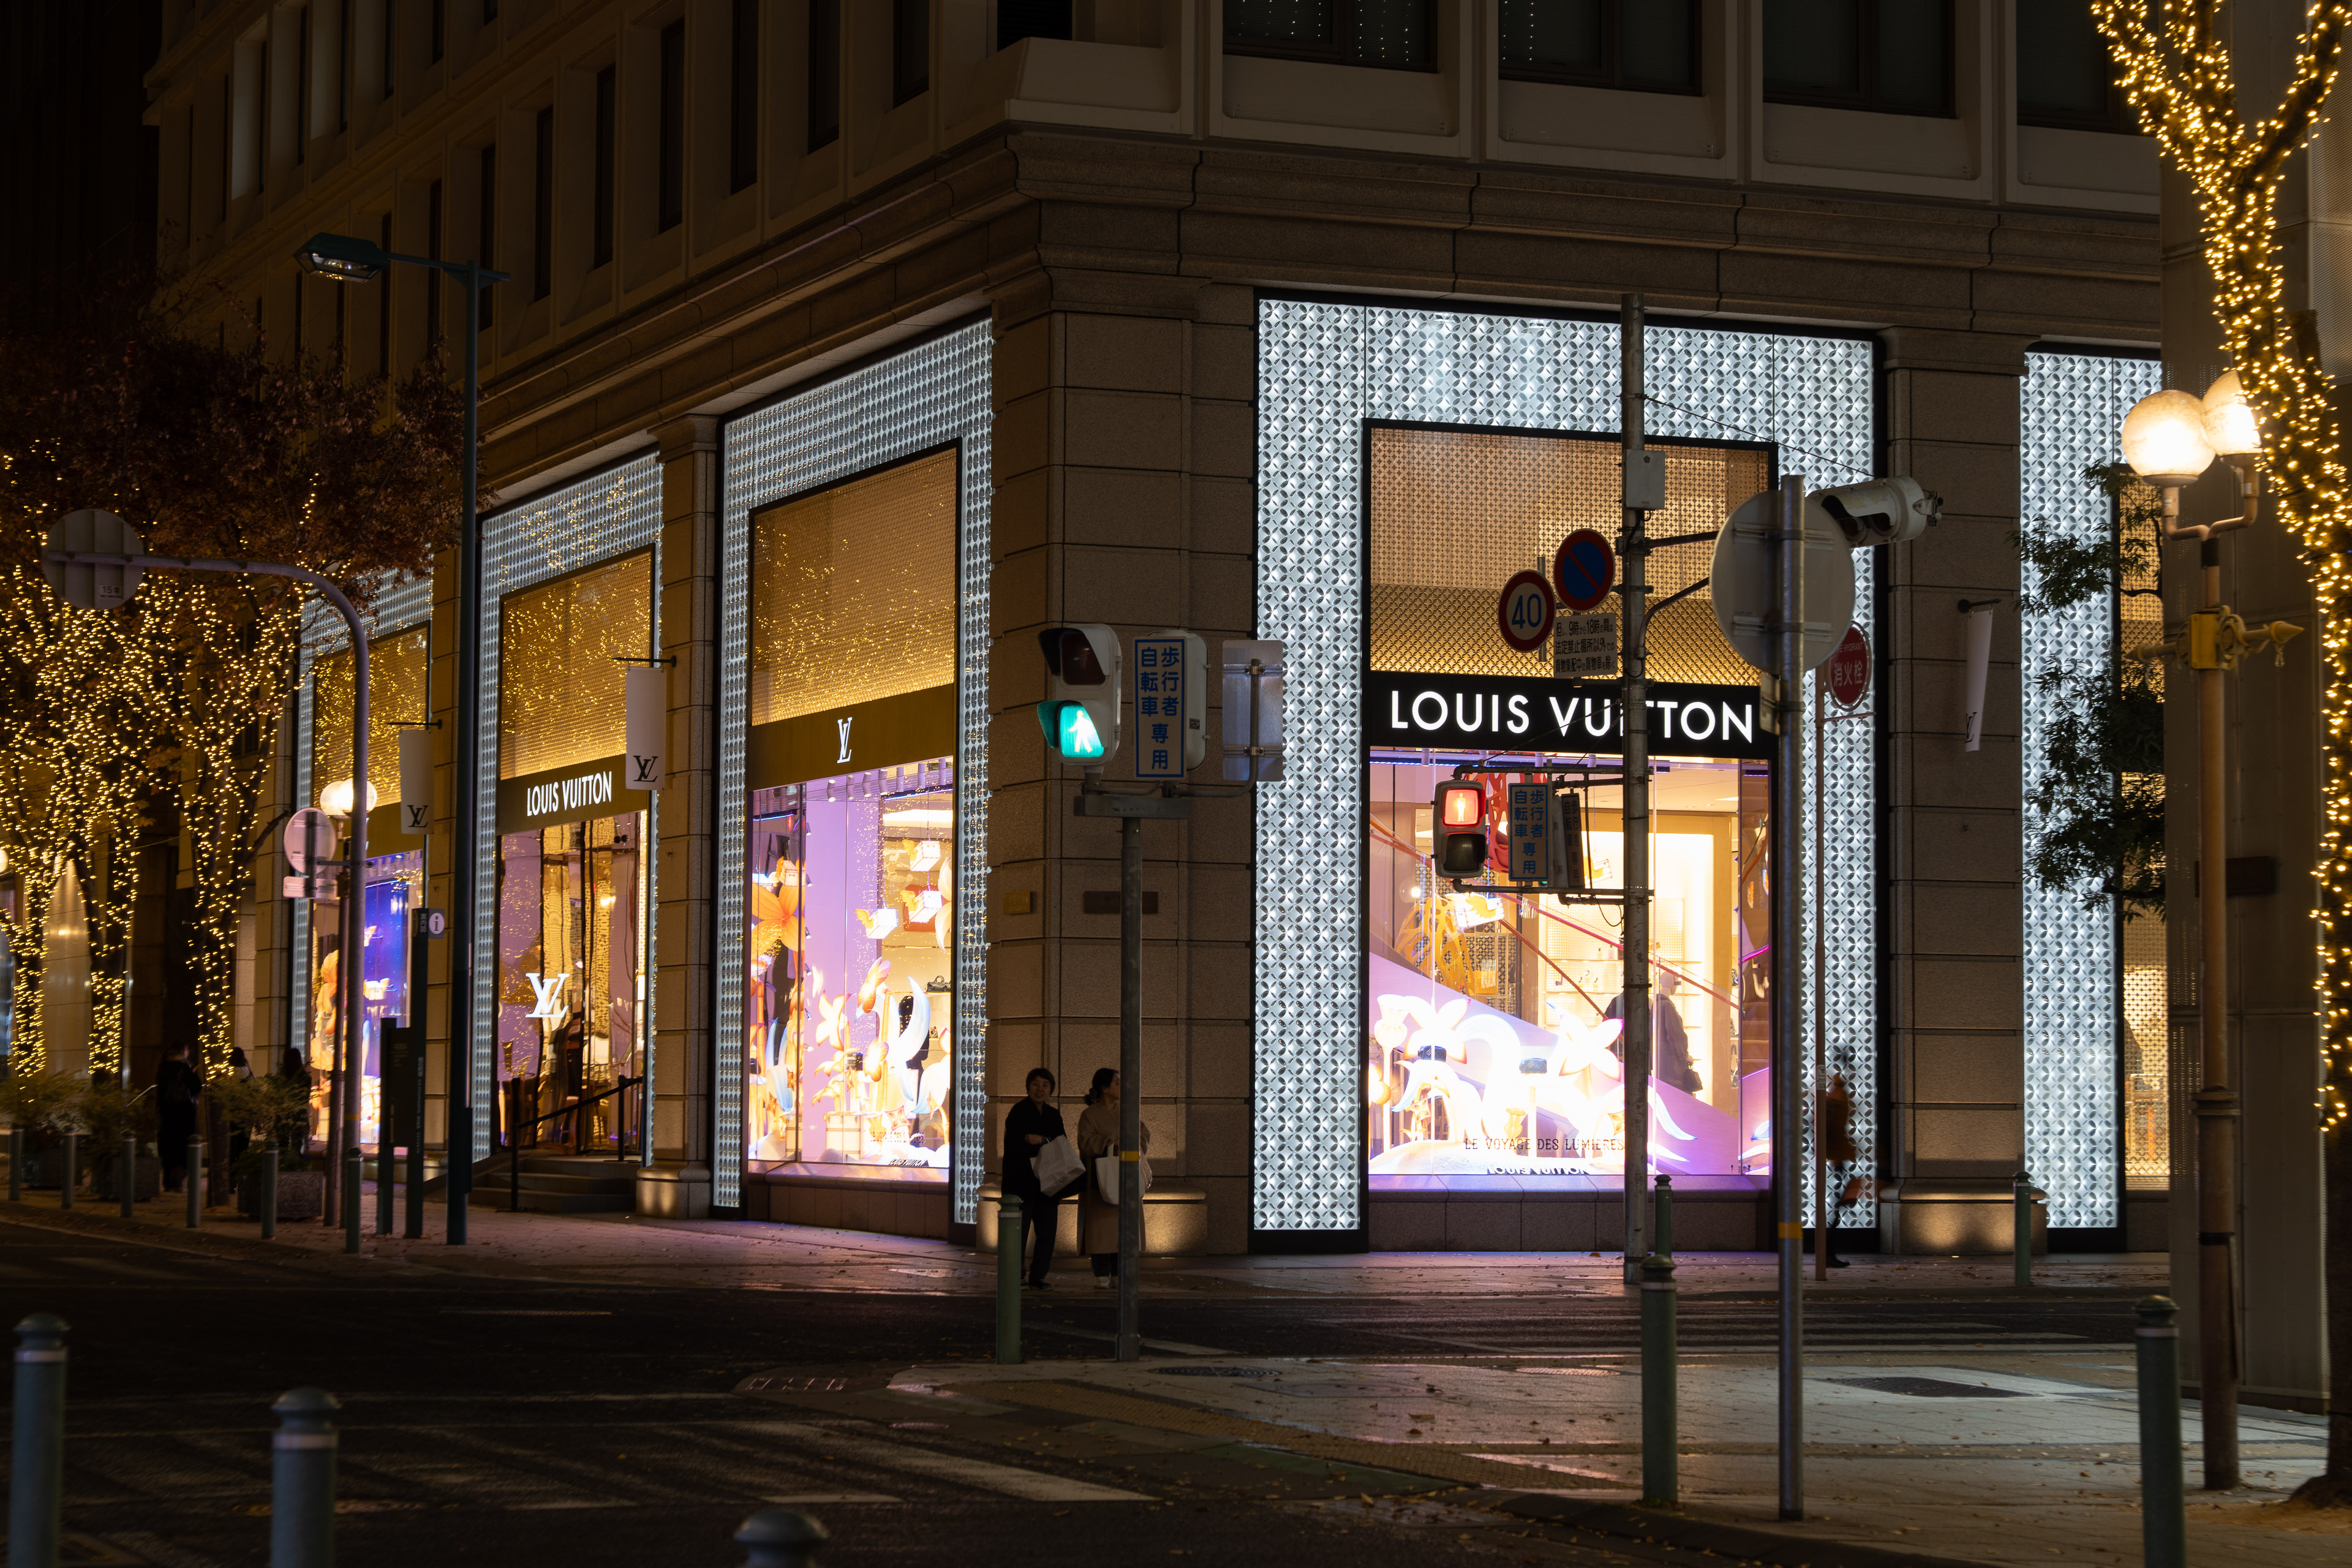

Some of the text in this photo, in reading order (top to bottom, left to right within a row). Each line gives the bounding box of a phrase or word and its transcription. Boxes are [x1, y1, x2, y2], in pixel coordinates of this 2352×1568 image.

[1512, 594, 1542, 628] 40
[1555, 637, 1615, 655] 法定禁止場所以外での
[1844, 643, 1864, 652] HYDRANT
[1140, 647, 1158, 717] 自転車
[1161, 646, 1180, 717] 歩行者
[1833, 660, 1863, 687] 消火栓
[1392, 690, 1752, 744] LOUIS VUTON
[1152, 723, 1169, 770] 専用
[527, 771, 612, 817] LOUIS VUITTON
[1514, 790, 1528, 838] 自転車
[1530, 790, 1544, 837] 歩行者
[1523, 842, 1536, 874] 専用
[1465, 1138, 1478, 1150] LE
[1486, 1138, 1531, 1150] VOYAGE
[1537, 1139, 1559, 1150] DES
